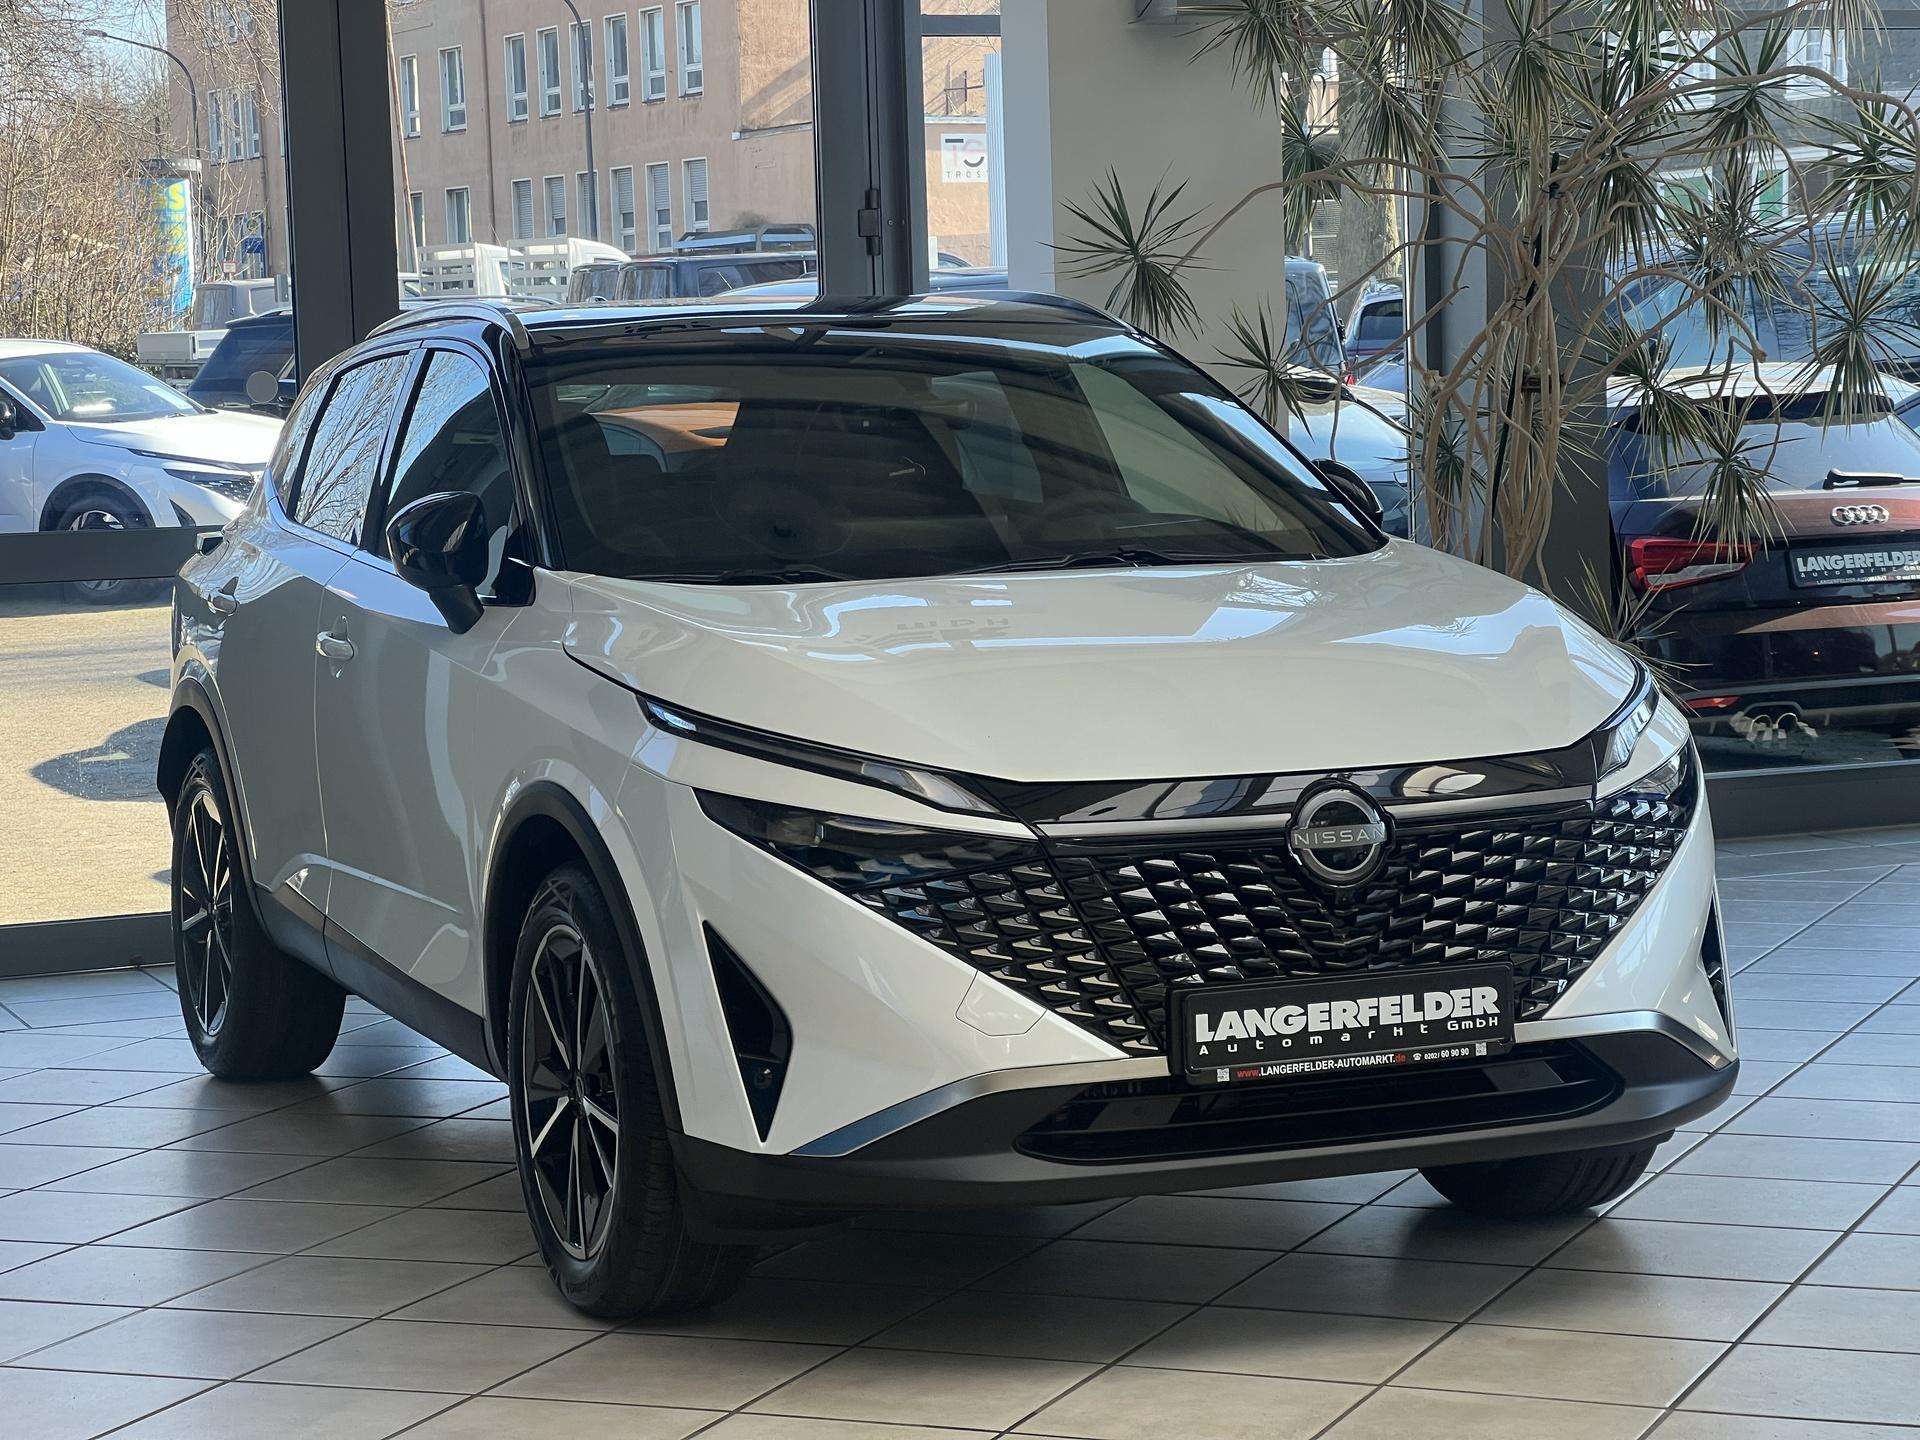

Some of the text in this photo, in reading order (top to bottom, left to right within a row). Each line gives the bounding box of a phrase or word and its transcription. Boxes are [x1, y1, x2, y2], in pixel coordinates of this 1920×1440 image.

[1797, 550, 1920, 572] LANGERFELDER
[1294, 829, 1385, 845] NISSAN
[1195, 986, 1501, 1043] LANGERFELDER
[1447, 1016, 1499, 1031] GmbH
[1440, 1049, 1450, 1058] 60
